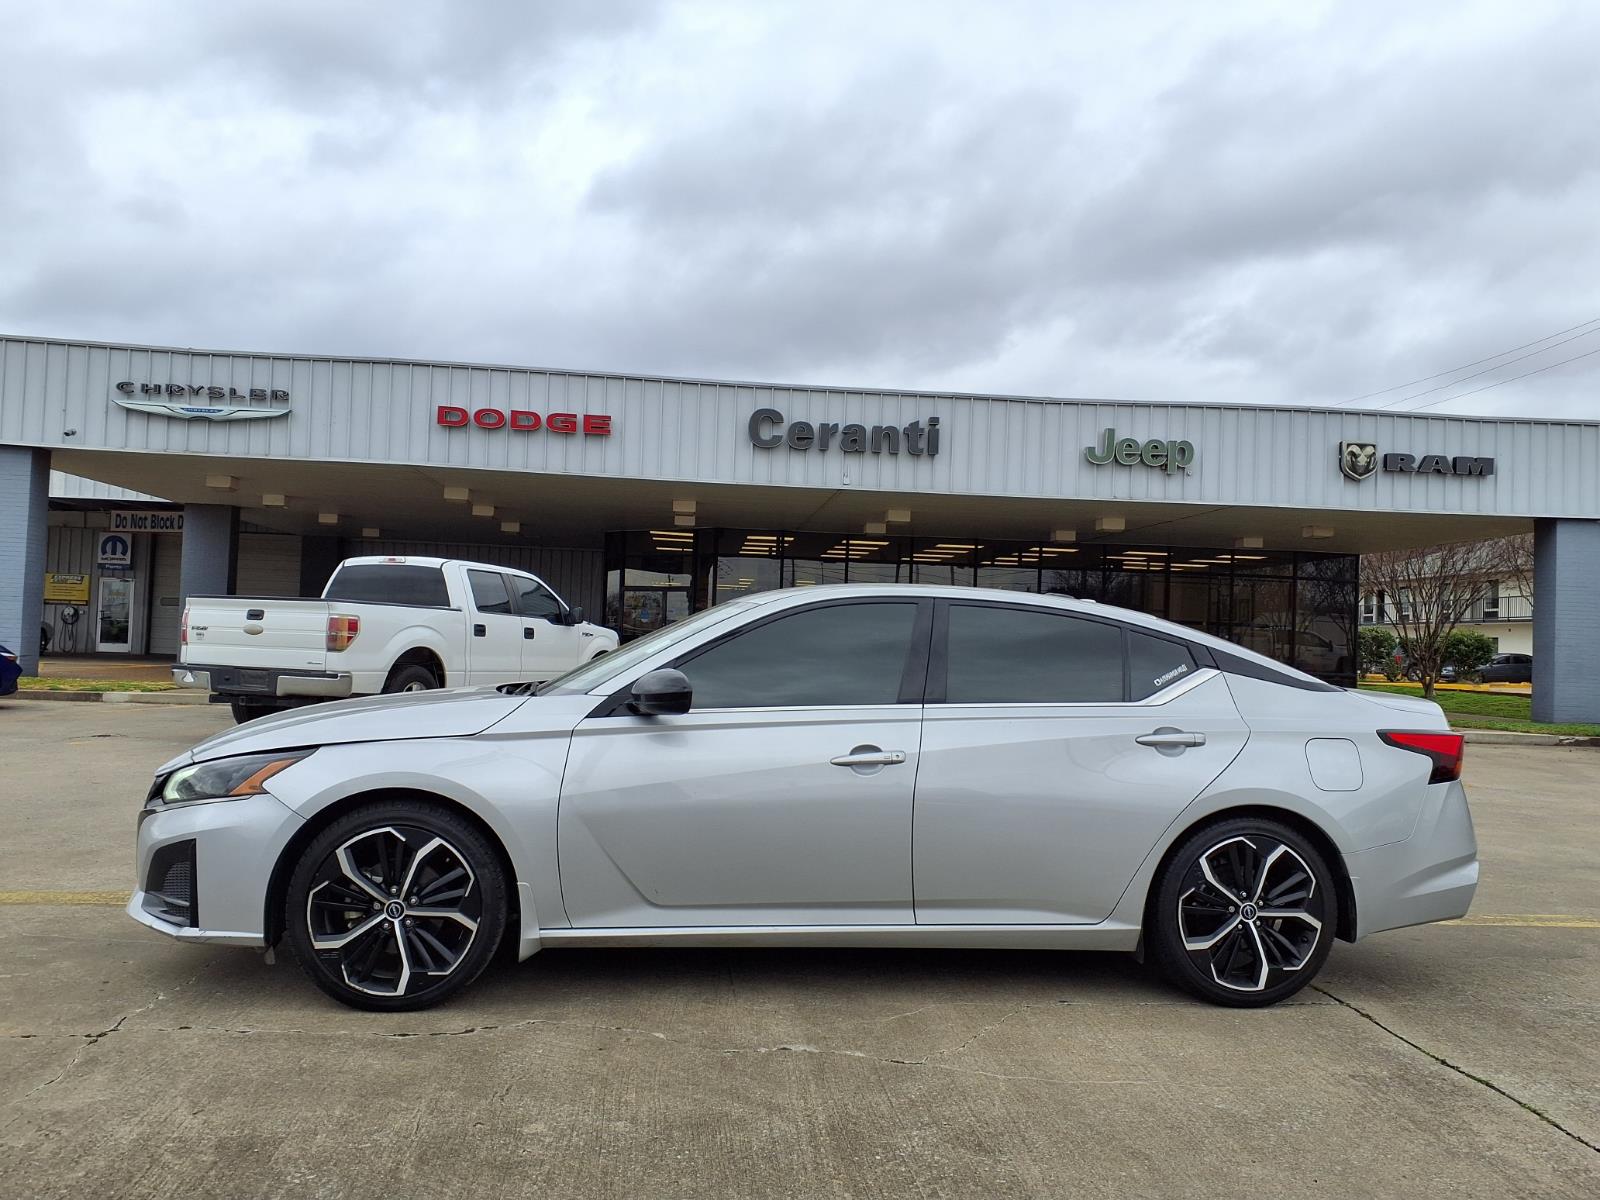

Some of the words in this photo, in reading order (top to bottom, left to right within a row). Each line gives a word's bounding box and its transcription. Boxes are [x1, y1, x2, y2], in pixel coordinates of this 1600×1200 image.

[116, 381, 290, 400] CHRYSLER
[437, 405, 612, 435] DODGE
[748, 408, 940, 455] Ceranti
[1086, 428, 1194, 474] Jeep
[1383, 453, 1495, 475] RAM
[115, 513, 128, 529] Do
[130, 513, 148, 529] Not
[150, 514, 176, 530] Block
